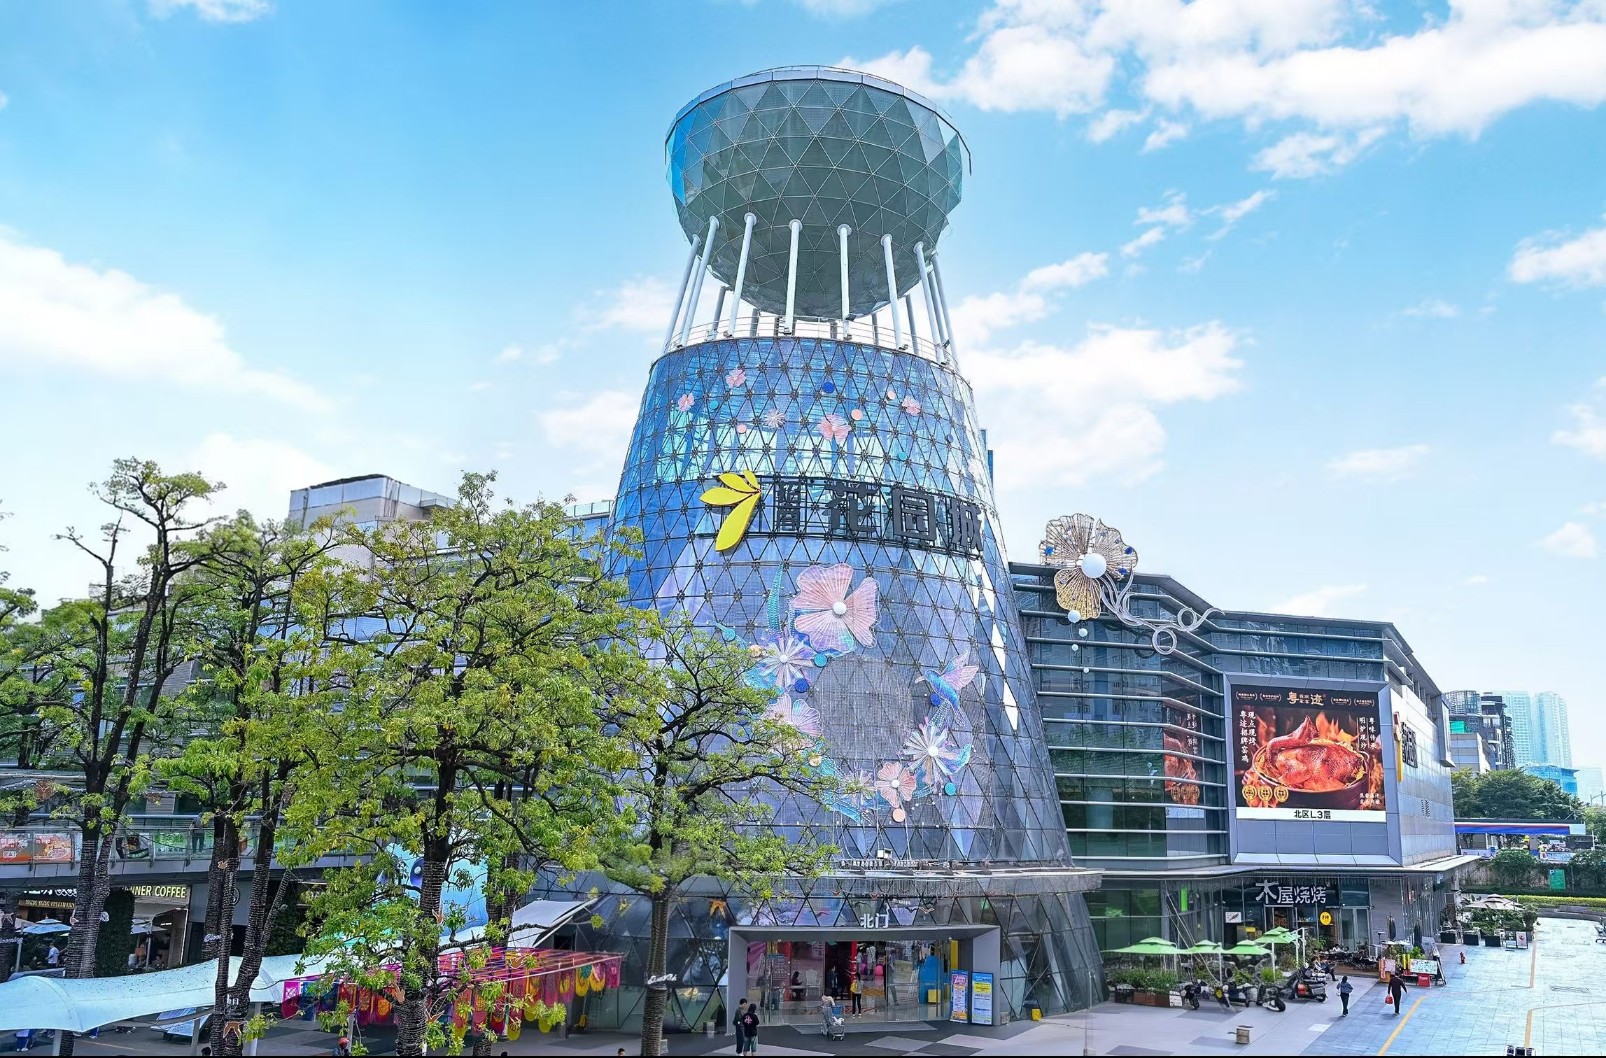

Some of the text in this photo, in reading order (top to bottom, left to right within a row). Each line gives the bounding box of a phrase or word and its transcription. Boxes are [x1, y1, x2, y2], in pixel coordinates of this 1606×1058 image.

[822, 481, 983, 550] 花园城
[1293, 809, 1332, 820] 北区L3层
[154, 886, 187, 899] COFFEE
[1255, 880, 1327, 905] 木屋烧烤
[860, 912, 889, 929] 北门
